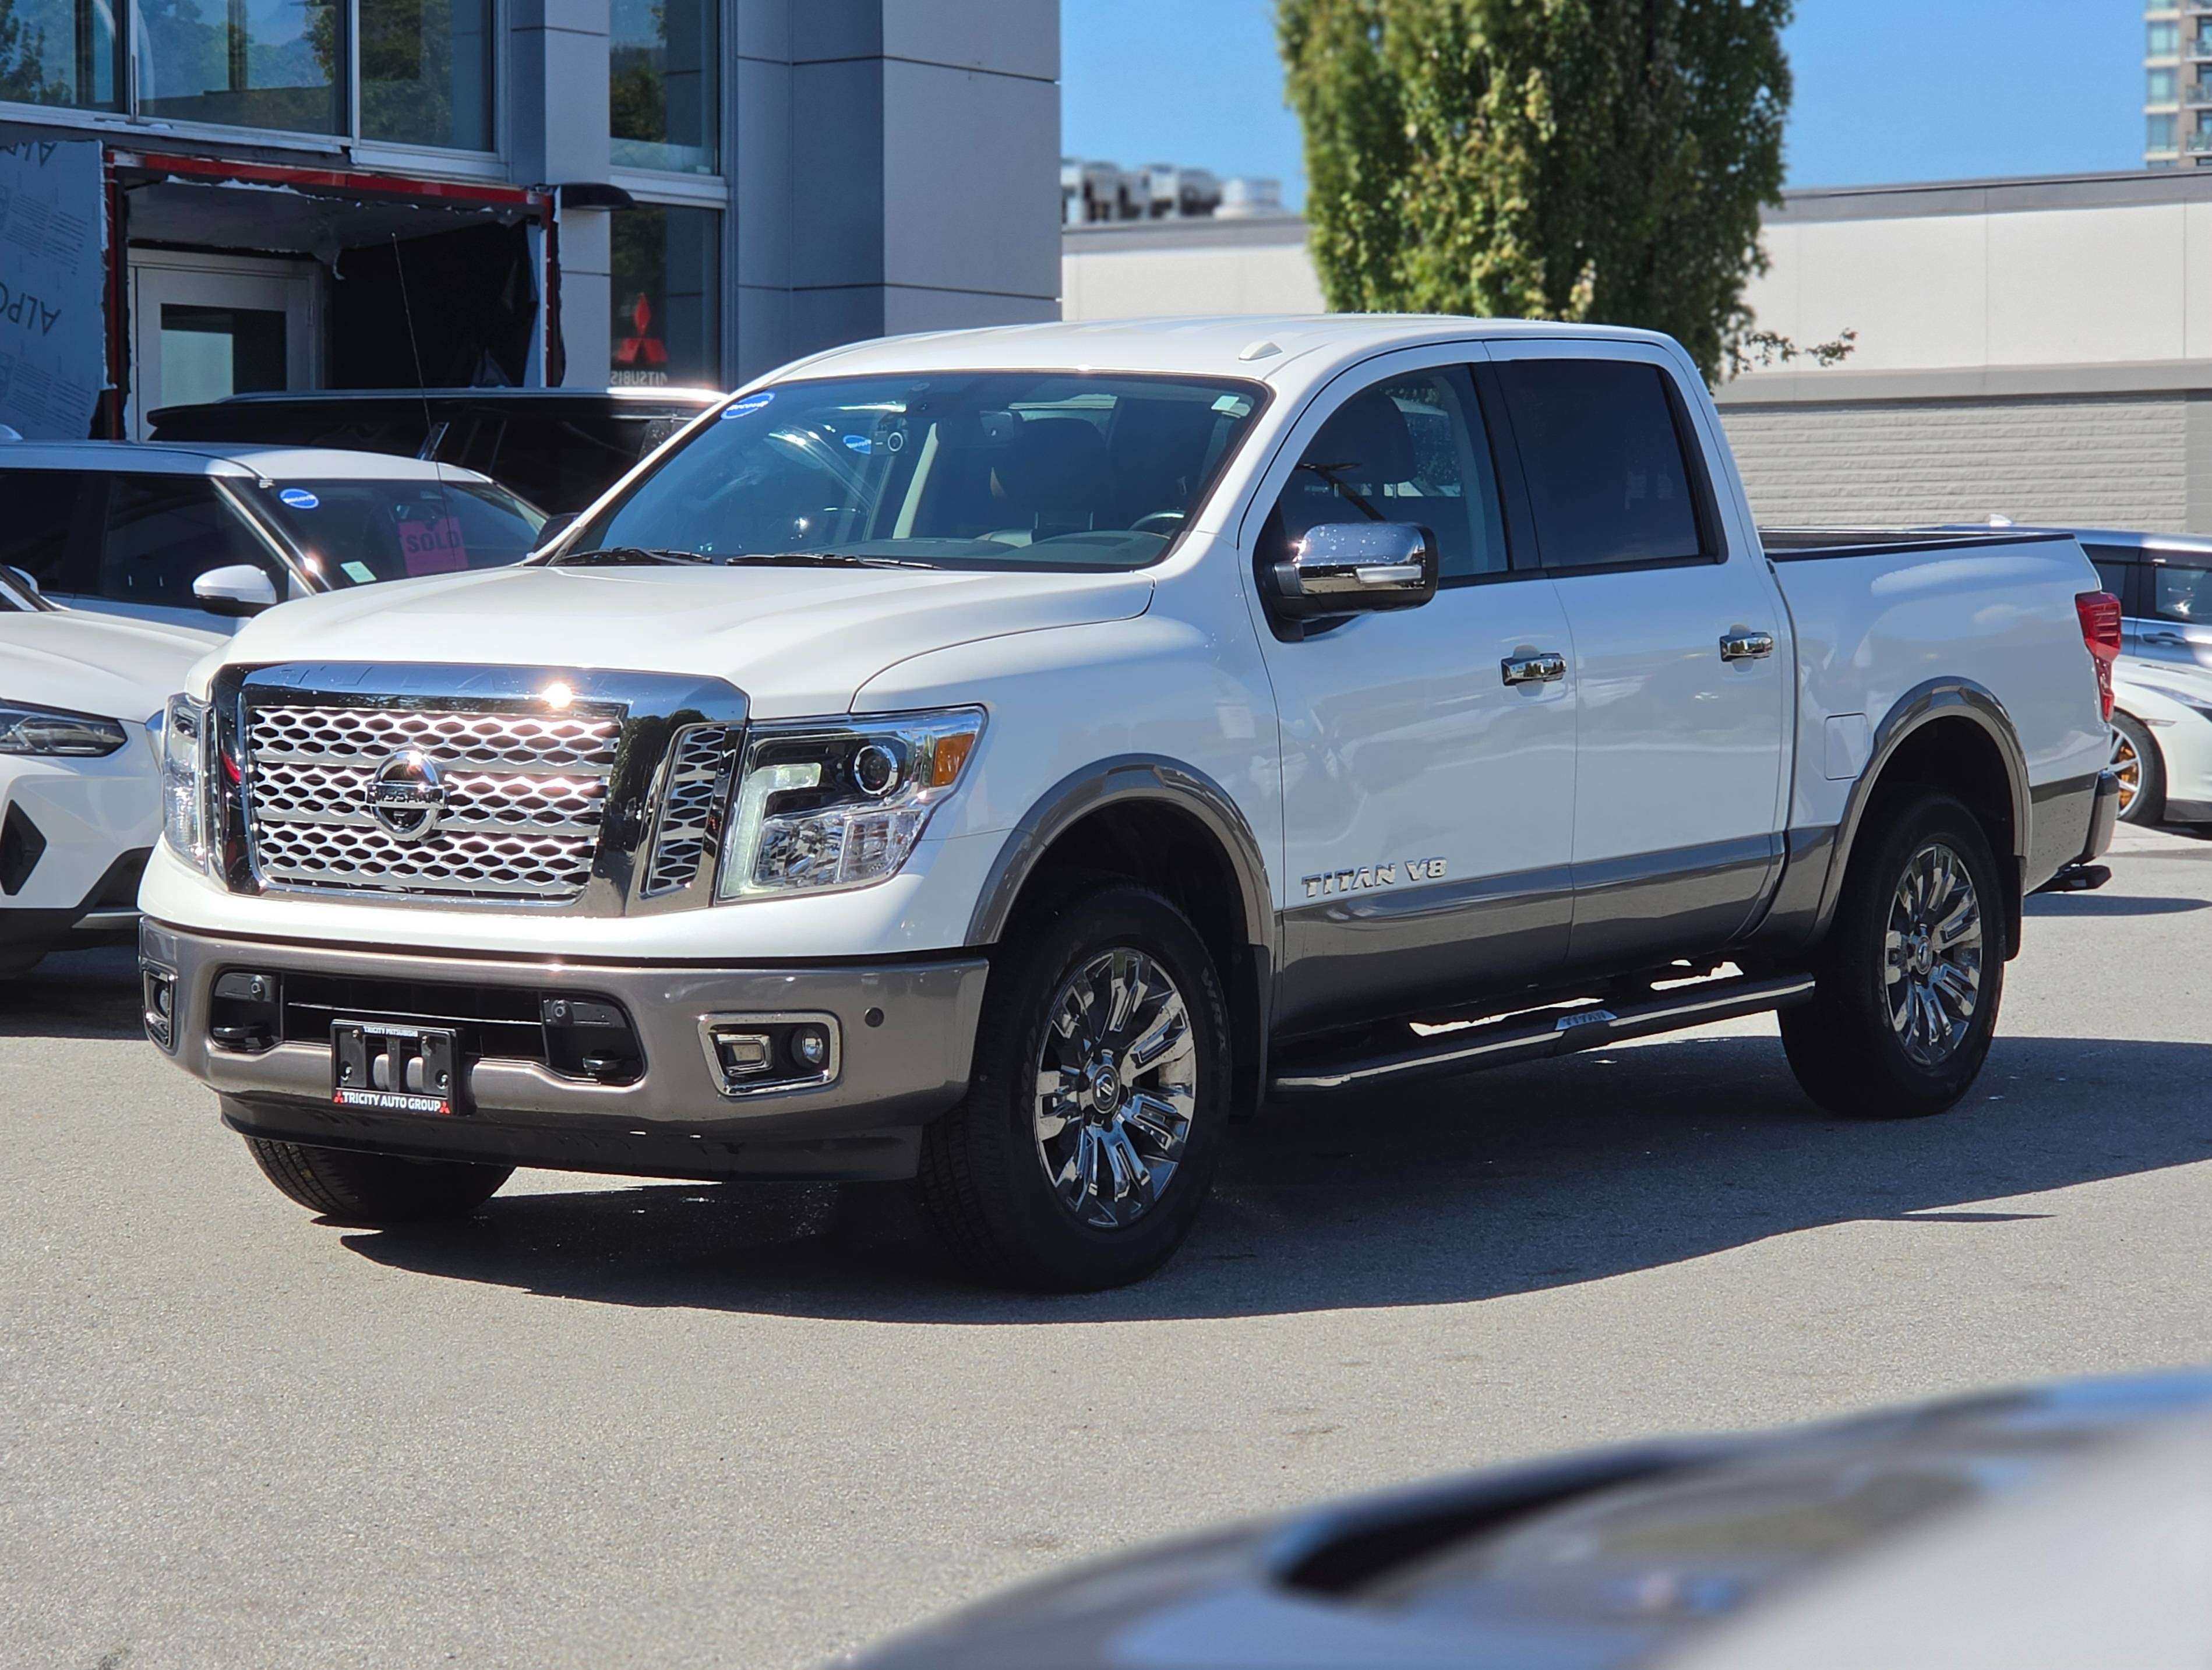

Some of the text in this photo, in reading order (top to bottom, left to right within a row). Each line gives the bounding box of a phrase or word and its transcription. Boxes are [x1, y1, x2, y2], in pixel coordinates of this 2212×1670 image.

[406, 531, 461, 553] SOLD
[1301, 856, 1447, 898] TITAN V8
[342, 1092, 441, 1111] TRICITY AUTO GROUP
